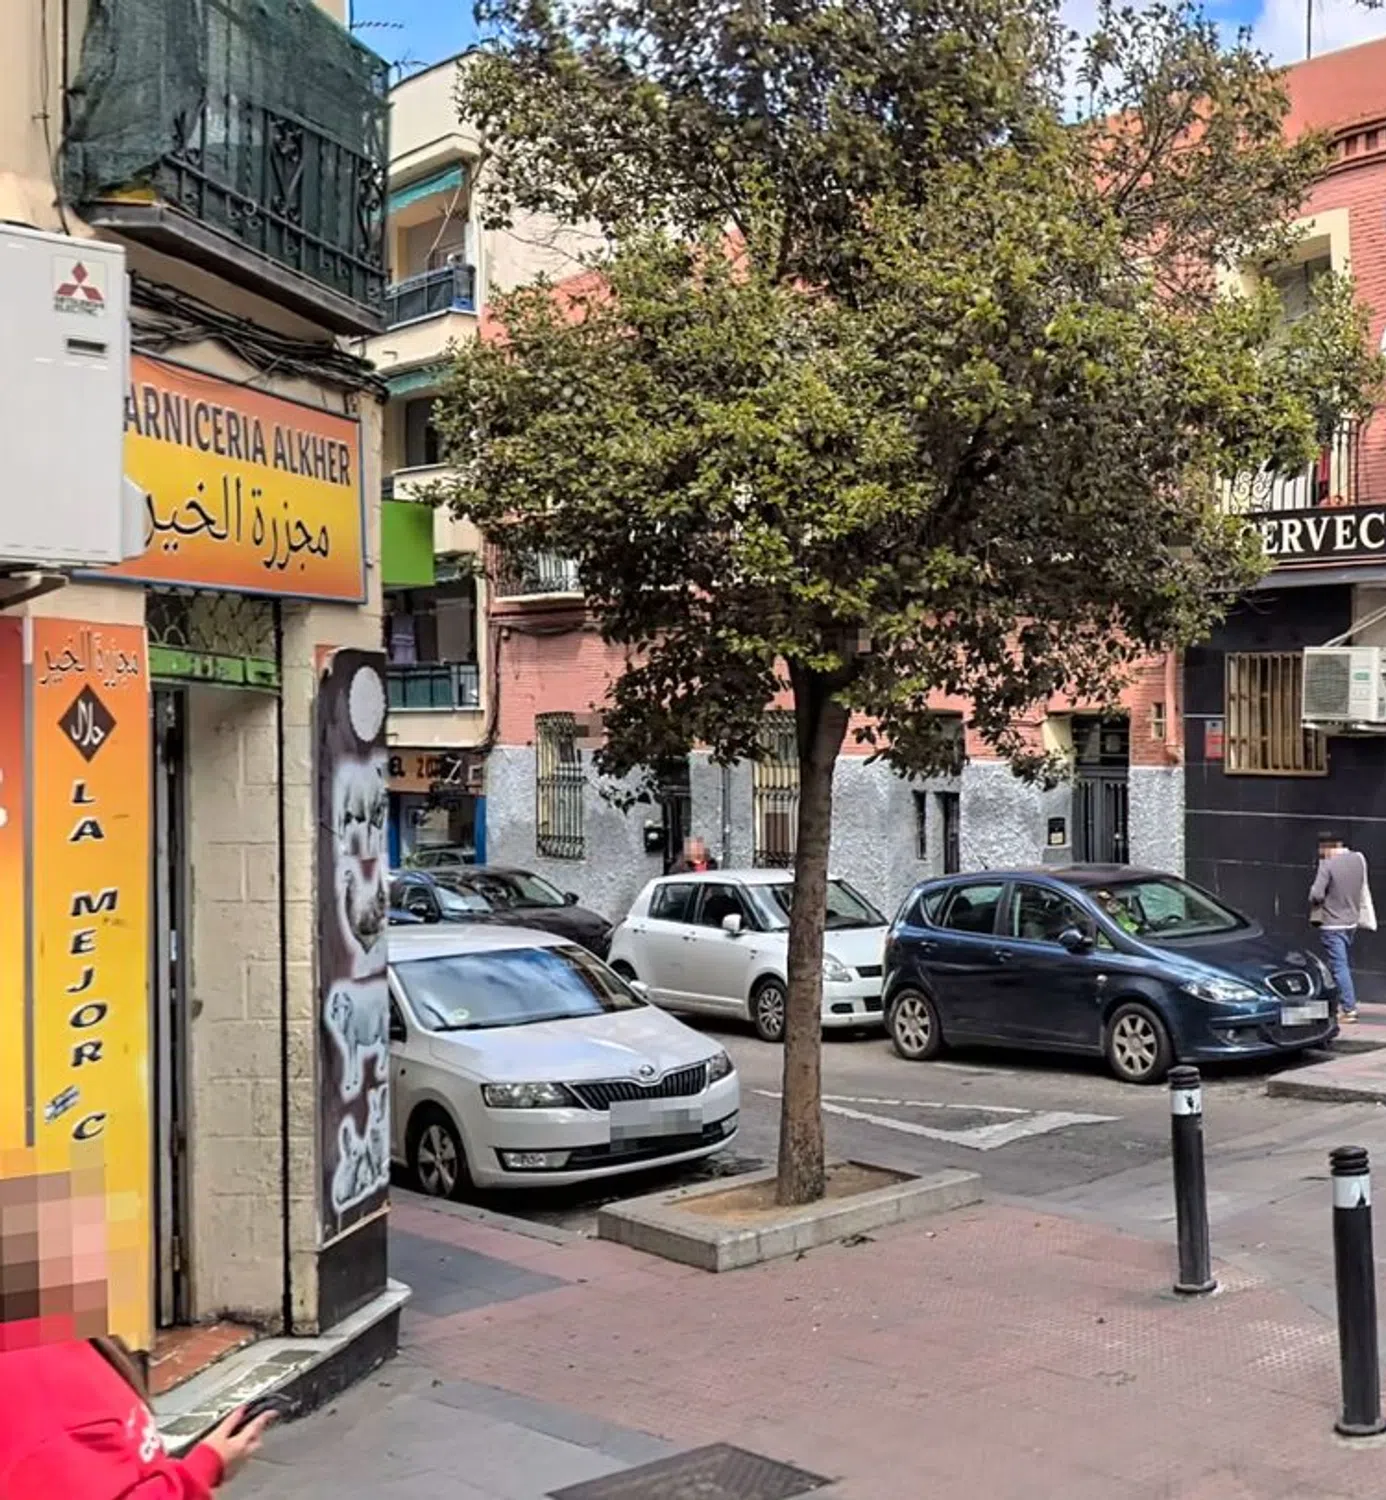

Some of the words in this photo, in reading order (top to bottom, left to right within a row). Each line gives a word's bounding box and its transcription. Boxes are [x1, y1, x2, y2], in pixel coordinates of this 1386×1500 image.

[123, 384, 268, 467] ARNICERIA
[273, 425, 351, 487] ALKHER
[251, 488, 330, 572] مجزرة
[69, 780, 105, 842] LA
[67, 889, 119, 1067] MEJOR
